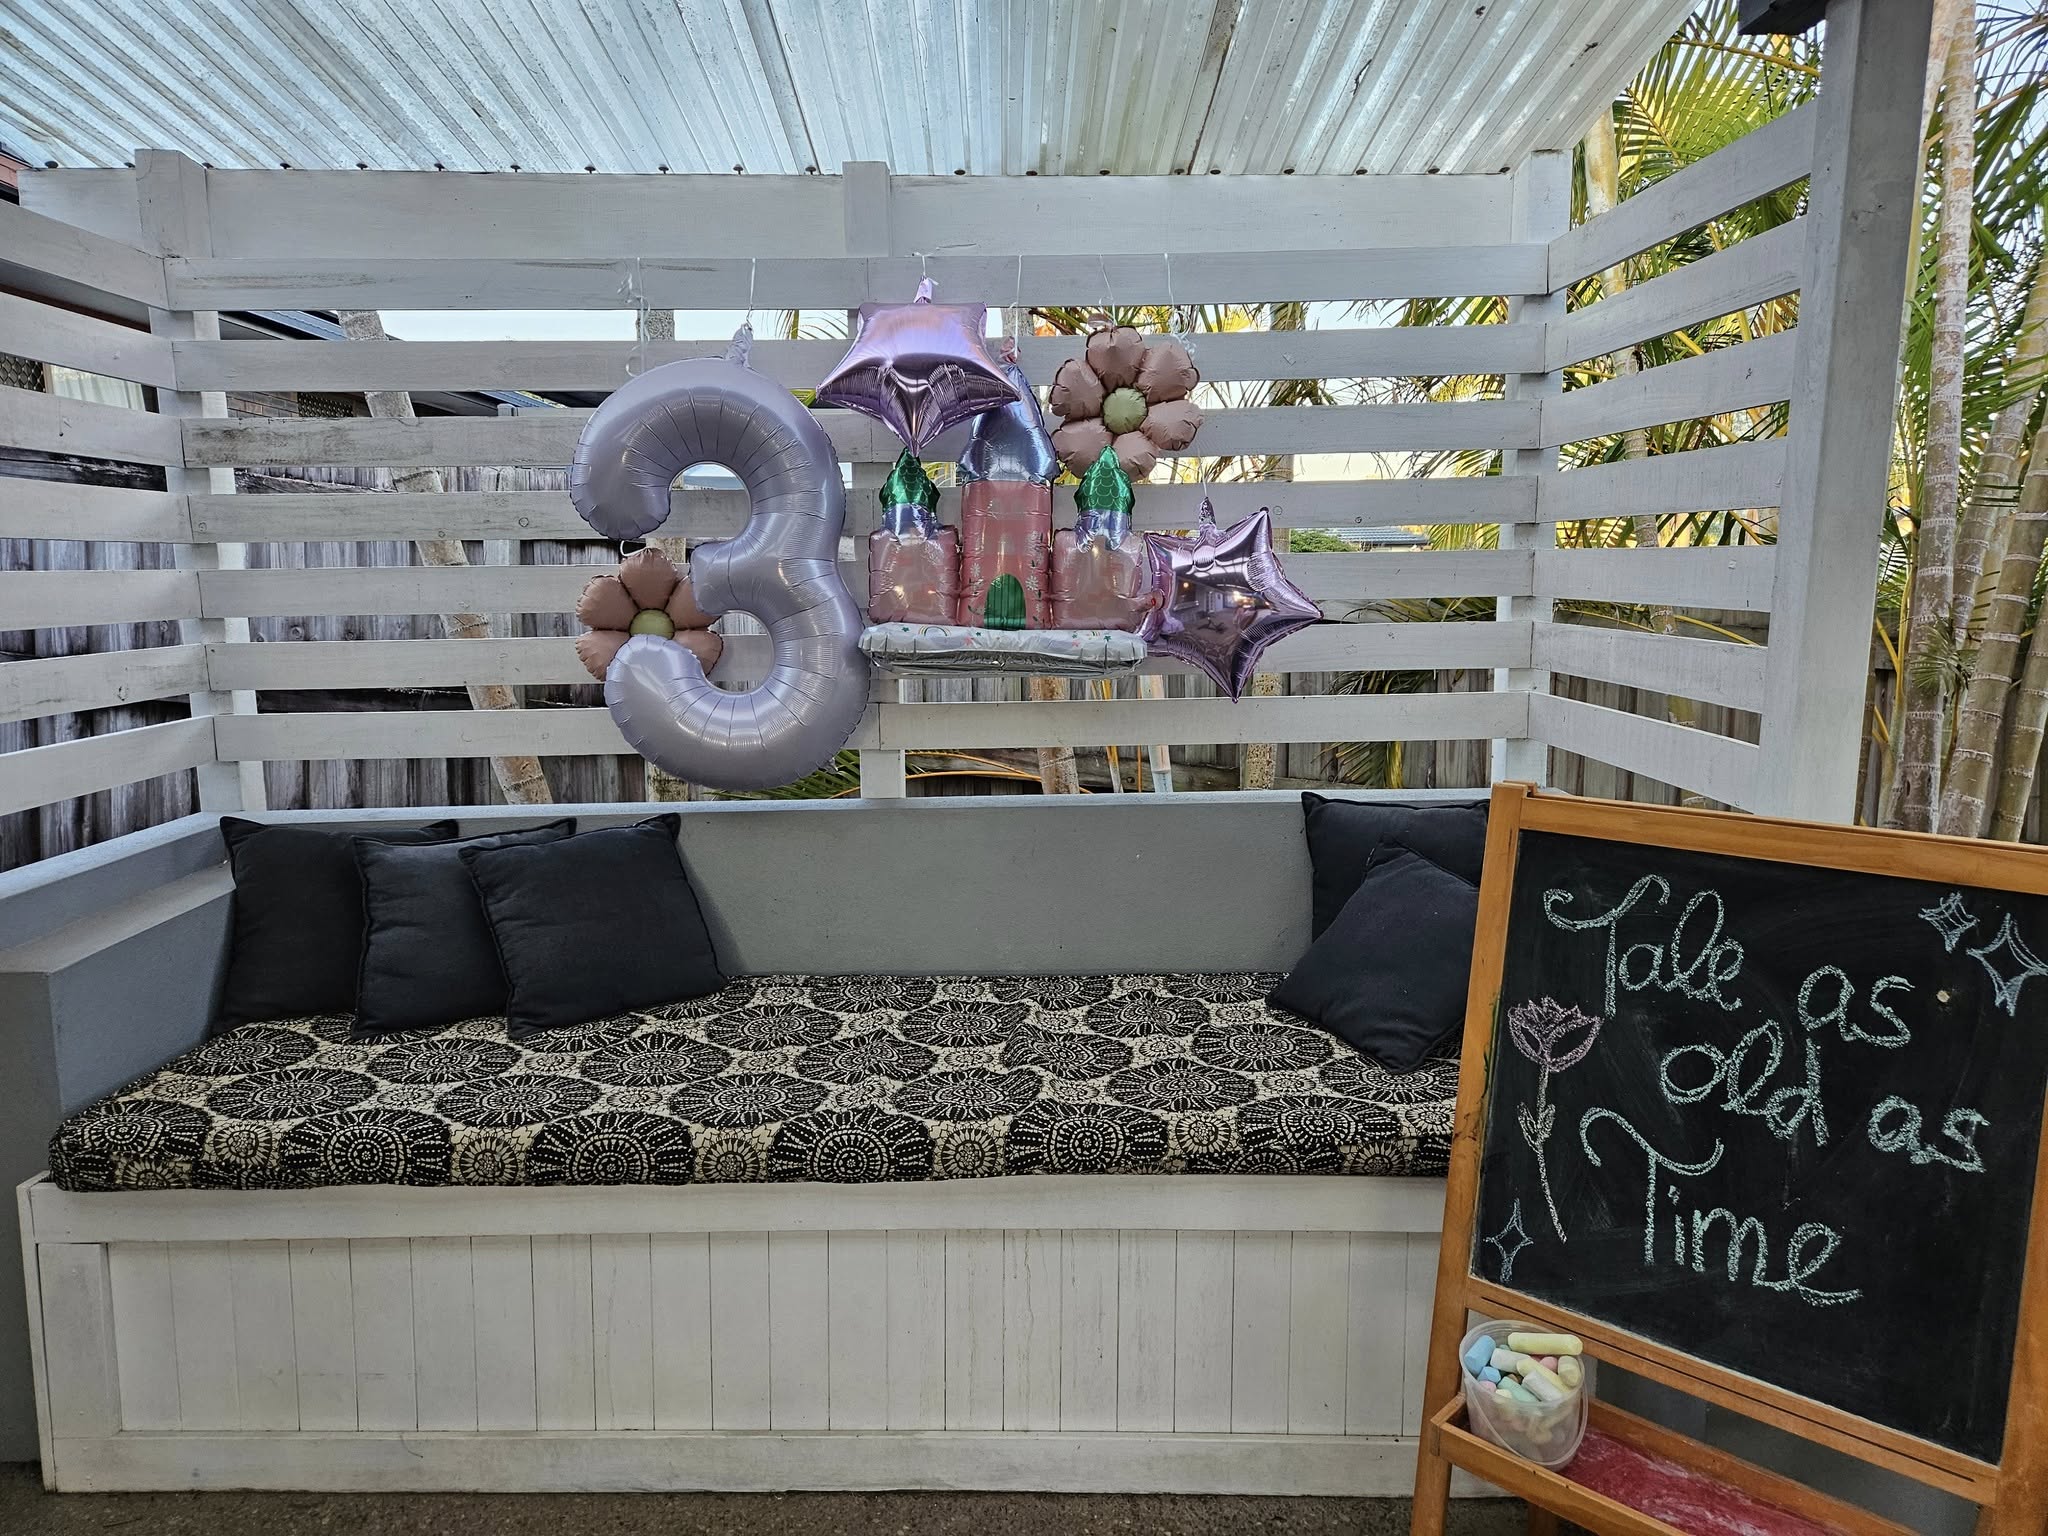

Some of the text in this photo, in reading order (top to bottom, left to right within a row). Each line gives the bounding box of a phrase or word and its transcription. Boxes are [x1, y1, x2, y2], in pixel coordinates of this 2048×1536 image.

[570, 358, 871, 791] 3
[1543, 873, 1915, 1049] Tale as
[1660, 1019, 1990, 1174] old as
[1579, 1107, 1864, 1306] Time
